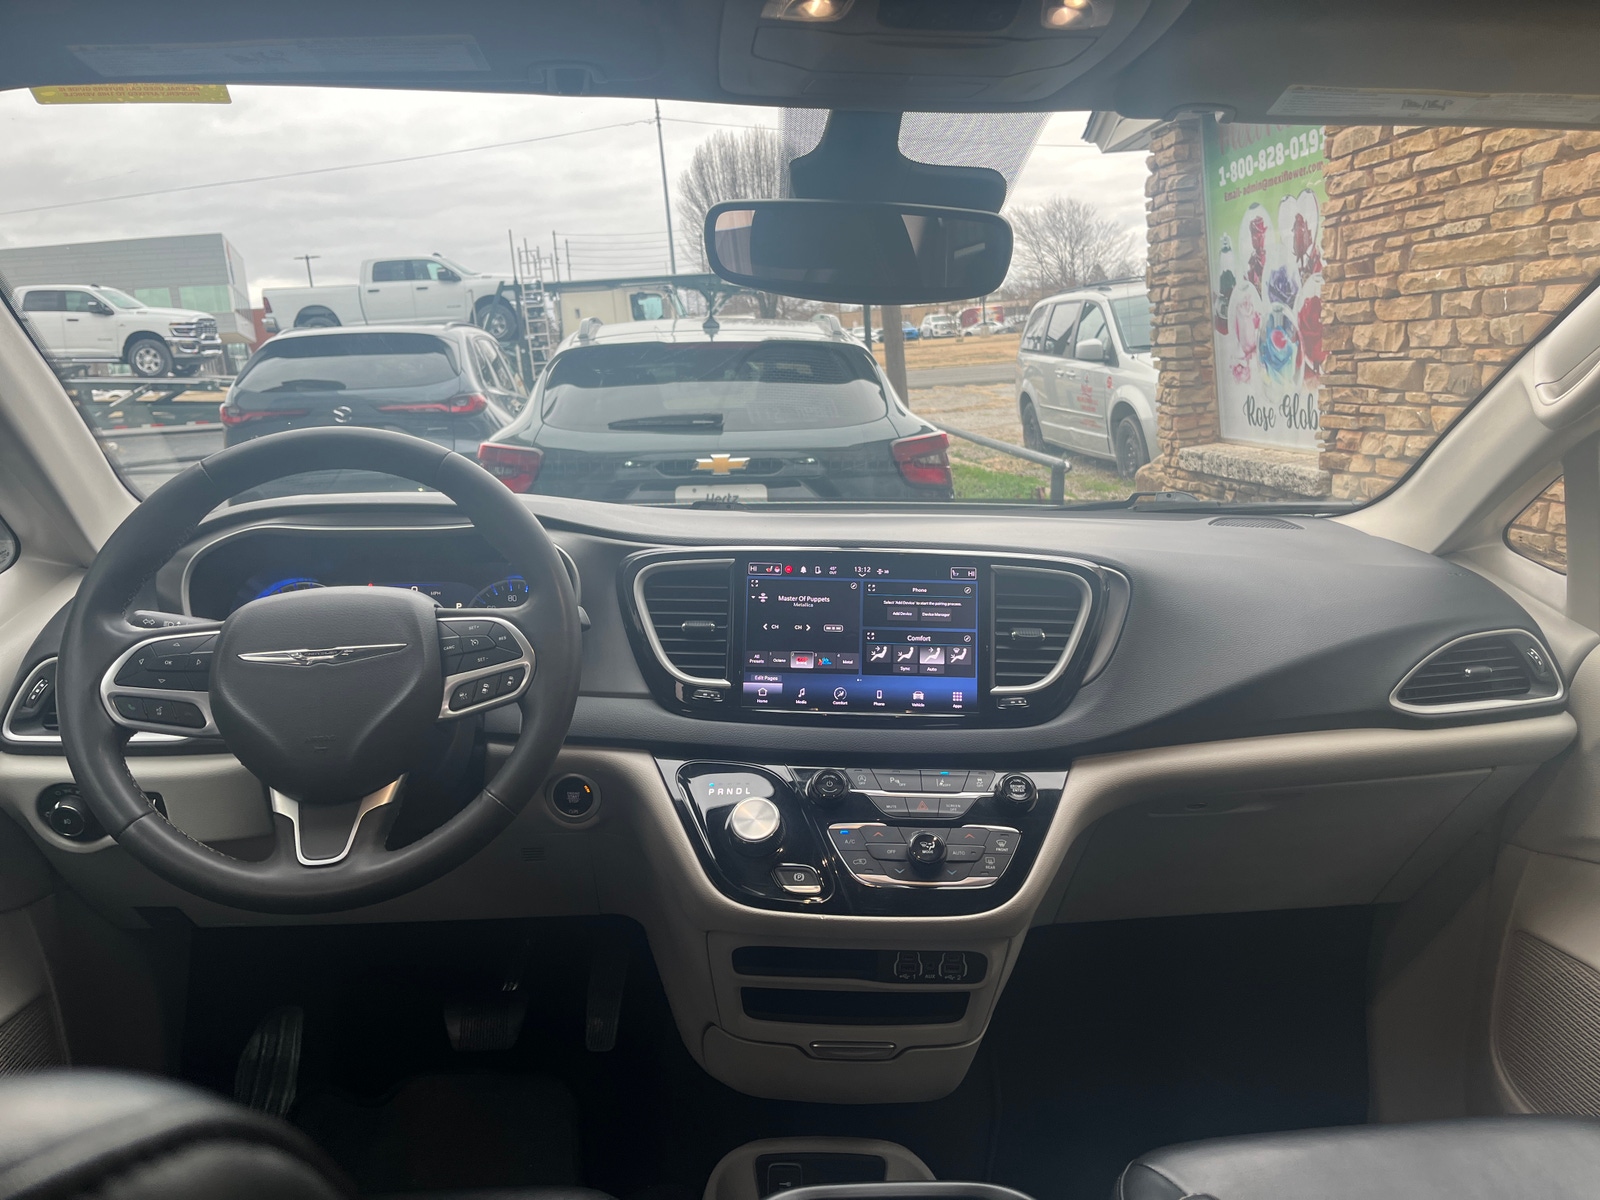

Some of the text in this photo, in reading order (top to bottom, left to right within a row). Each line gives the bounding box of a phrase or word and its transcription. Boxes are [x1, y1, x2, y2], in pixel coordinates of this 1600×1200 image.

[1243, 393, 1326, 431] Rose Glob
[706, 494, 740, 502] Hertz
